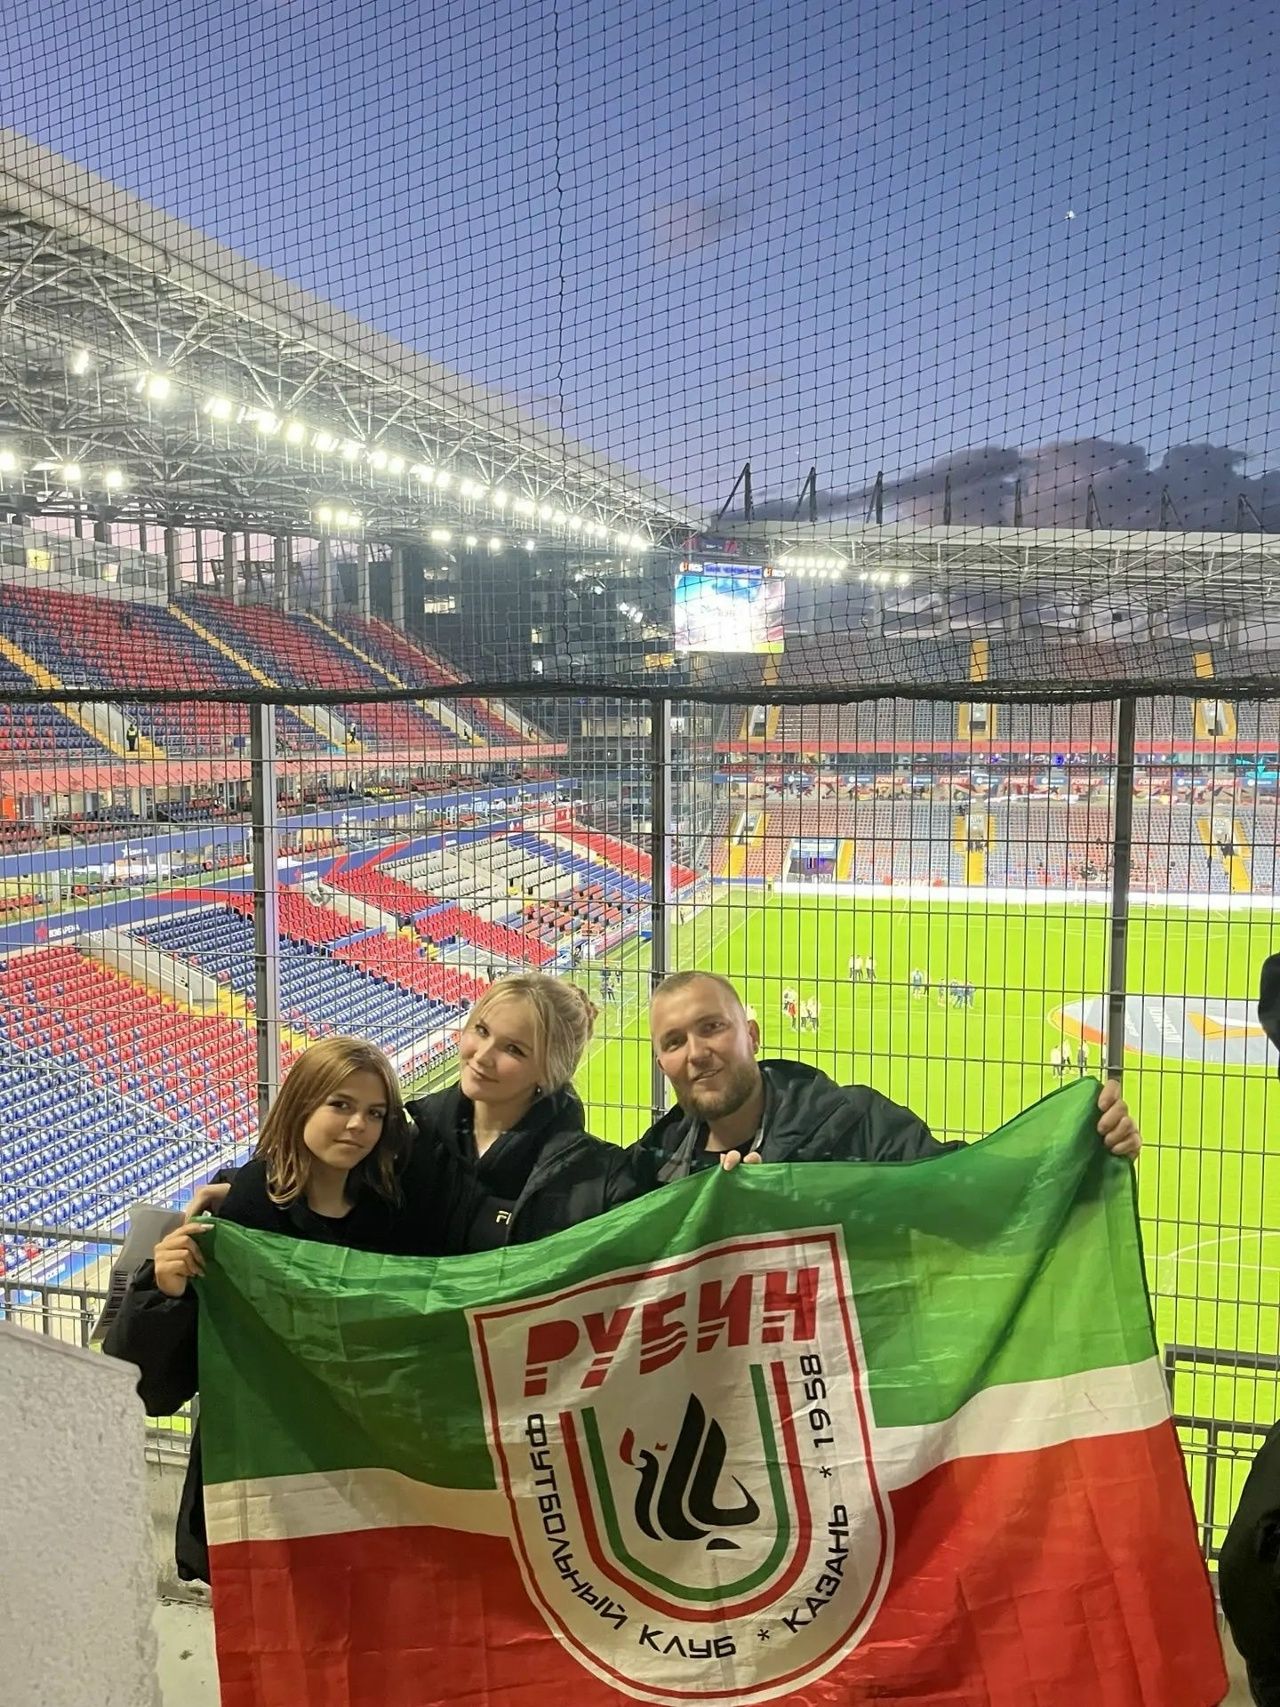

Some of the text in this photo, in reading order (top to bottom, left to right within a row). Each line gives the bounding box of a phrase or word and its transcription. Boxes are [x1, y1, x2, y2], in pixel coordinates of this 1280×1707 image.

[496, 1210, 512, 1225] FI
[524, 1267, 820, 1397] РУБИН
[525, 1353, 848, 1659] ФУТБОЛЬНЫЙ КЛУБ КАЗАНЬ 1958
